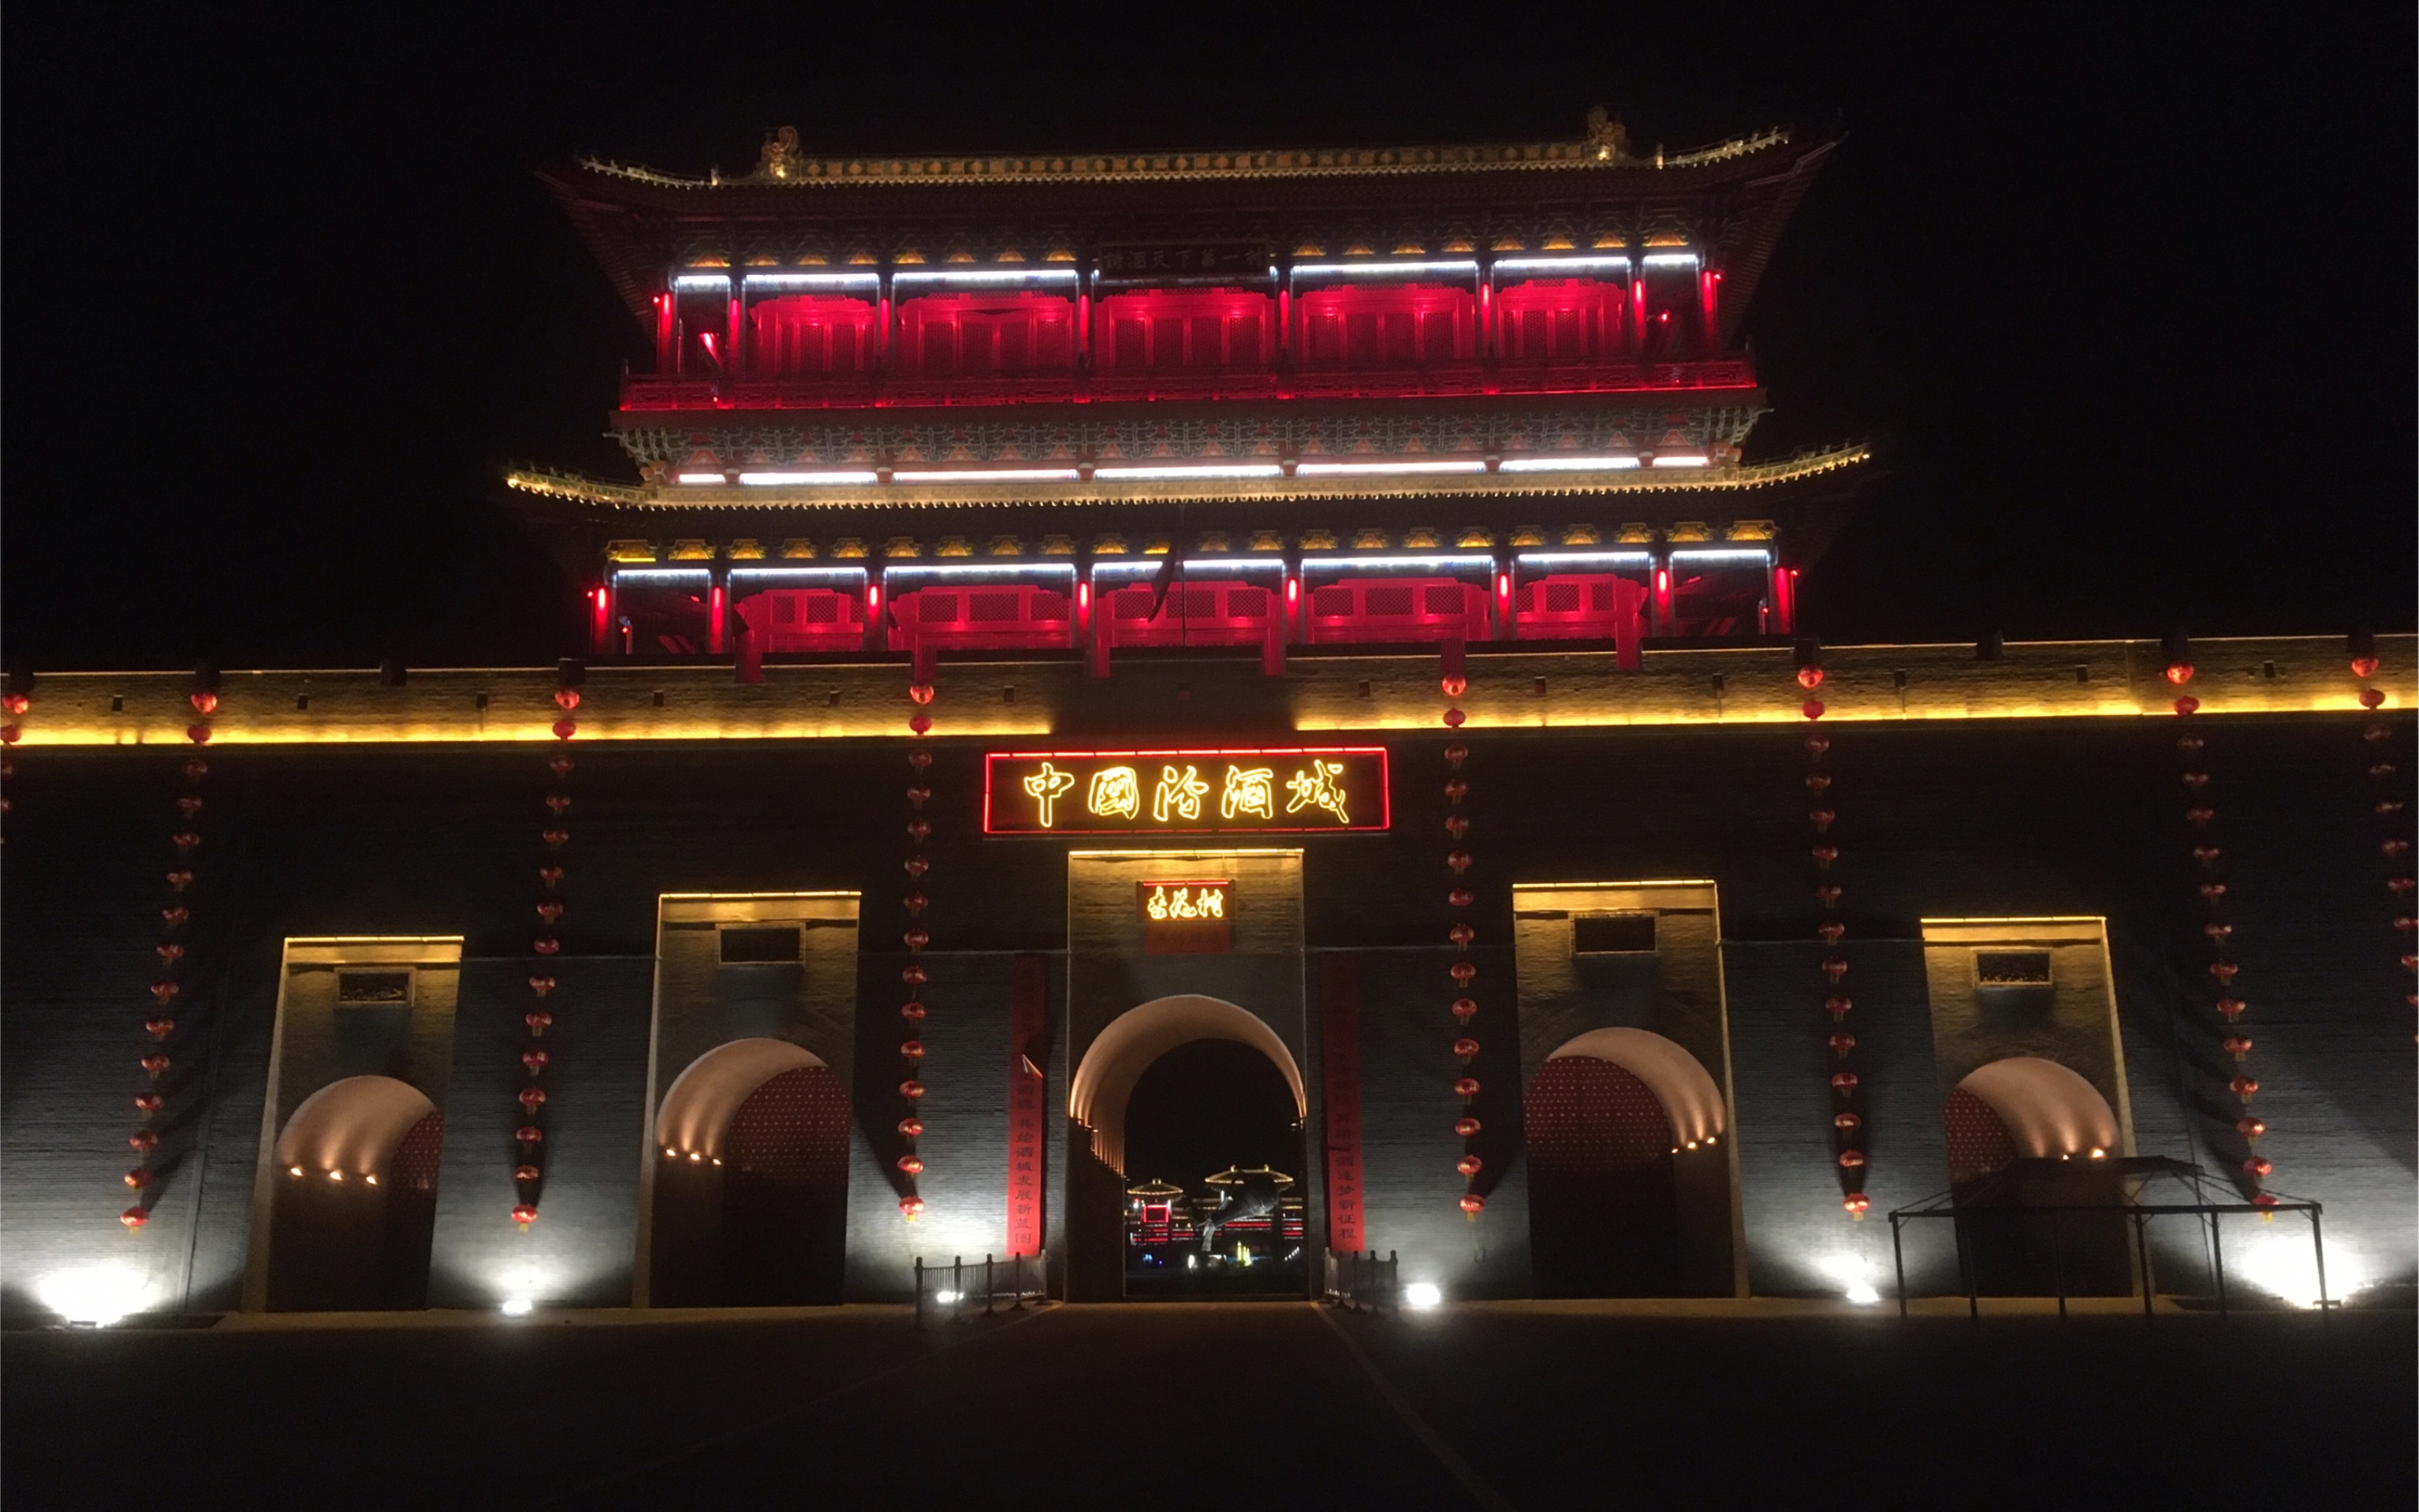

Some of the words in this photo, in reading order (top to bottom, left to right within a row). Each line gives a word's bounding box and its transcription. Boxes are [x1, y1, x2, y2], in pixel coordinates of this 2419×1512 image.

[1023, 758, 1350, 829] 中國汾酒城
